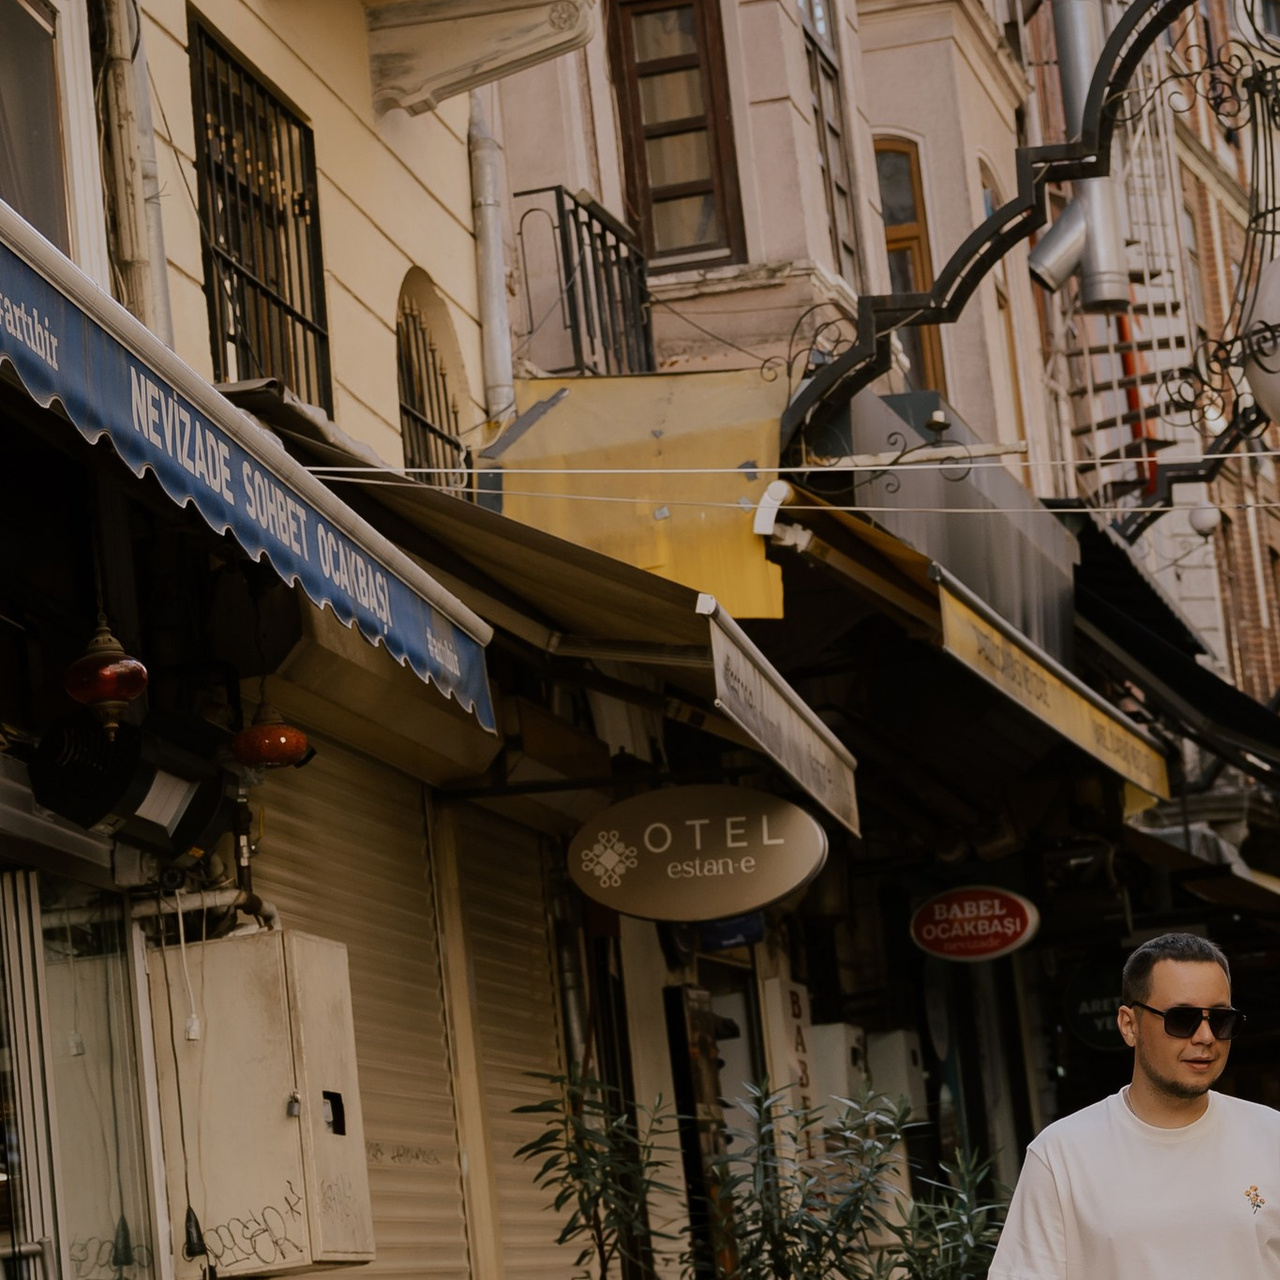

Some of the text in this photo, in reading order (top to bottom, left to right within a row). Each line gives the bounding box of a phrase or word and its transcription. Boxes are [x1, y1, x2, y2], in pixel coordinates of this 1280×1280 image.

[130, 365, 394, 635] NEVİZADE SOHBET OCAKBAŞI
[643, 814, 785, 854] OTEL
[932, 898, 1008, 921] BABEL
[921, 917, 1022, 941] OCAKBAŞI
